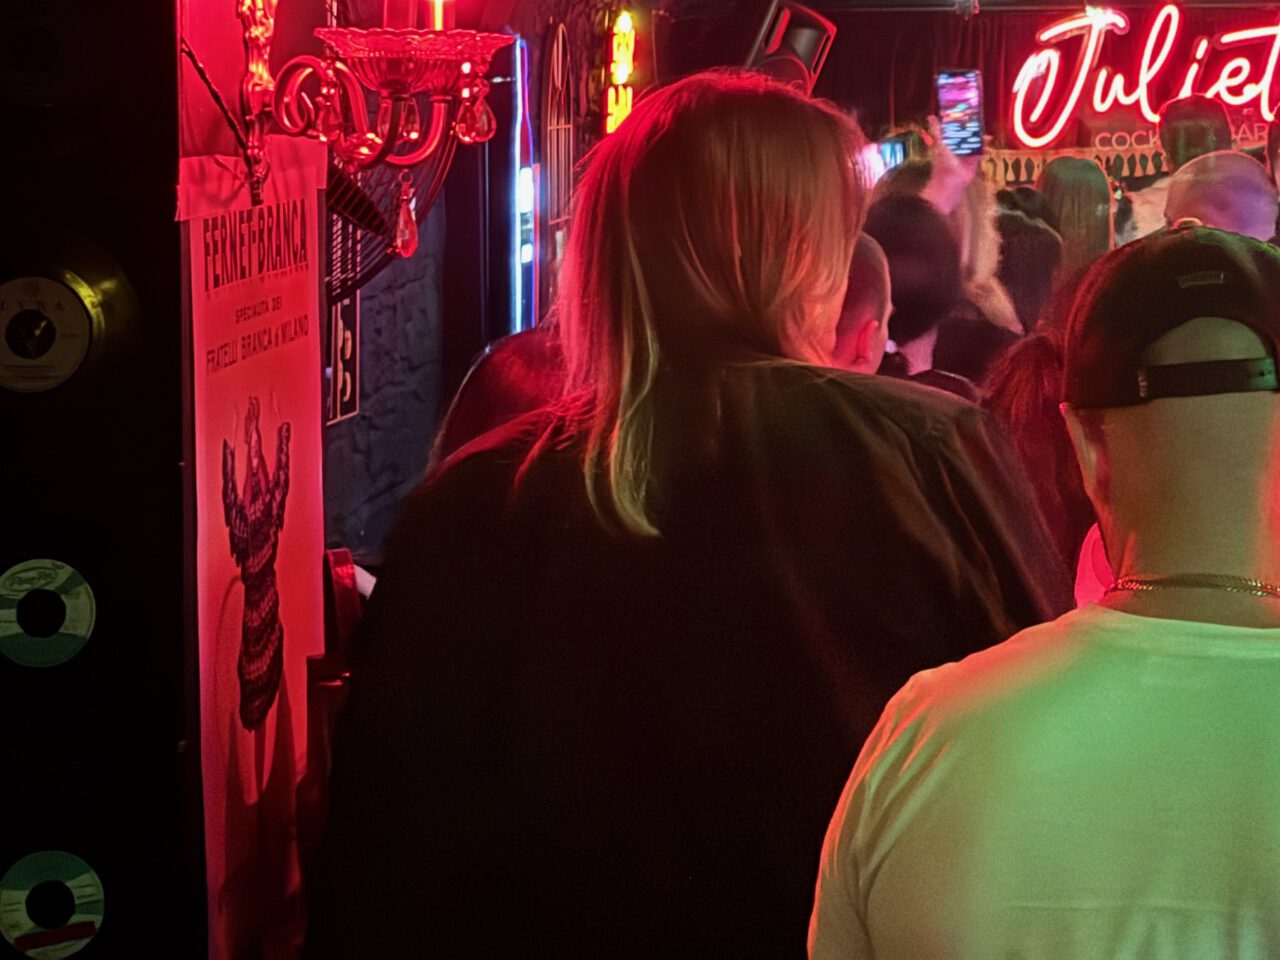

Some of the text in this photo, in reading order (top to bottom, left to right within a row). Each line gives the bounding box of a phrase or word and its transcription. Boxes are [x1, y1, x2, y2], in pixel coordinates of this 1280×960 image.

[203, 198, 309, 292] FERNET-BRANCA
[206, 340, 238, 376] FRATELLI
[241, 326, 272, 360] BRANCA
[281, 314, 309, 346] MILANO
